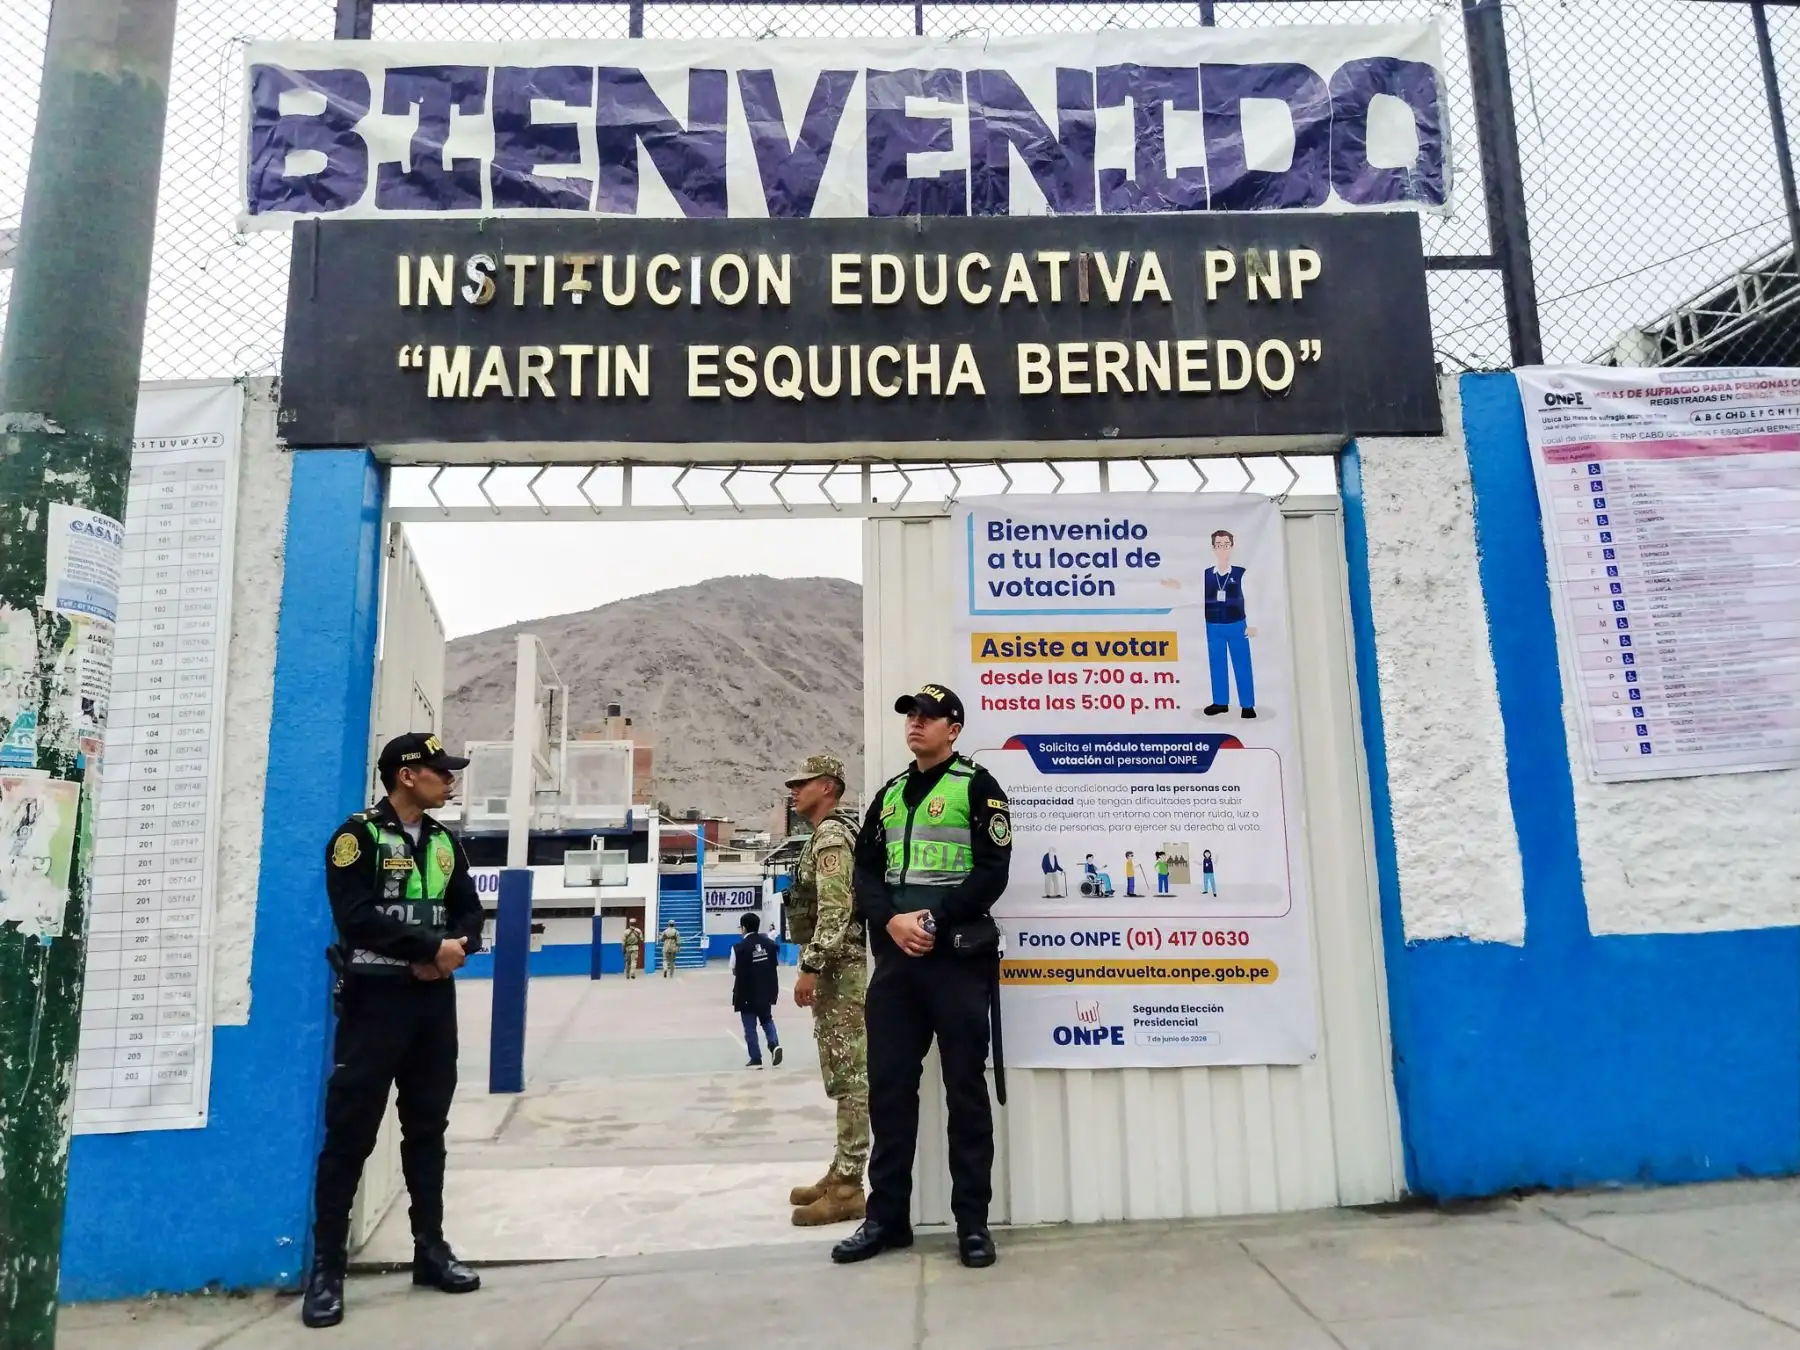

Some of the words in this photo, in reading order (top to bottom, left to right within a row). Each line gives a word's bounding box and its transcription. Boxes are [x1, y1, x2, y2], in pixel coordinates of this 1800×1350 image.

[247, 56, 1448, 218] BIENVENIDO
[398, 252, 791, 307] INSTITUCION
[831, 250, 1171, 305] EDUCATIVA
[1206, 249, 1322, 301] PNP
[688, 342, 986, 402] ESQUICHA
[1544, 392, 1584, 407] ONPE
[1650, 394, 1717, 407] REGISTRADAS
[1720, 393, 1733, 401] EN
[987, 517, 1148, 541] Bienvenido
[987, 551, 1005, 569] a
[1012, 549, 1042, 569] tu
[1049, 547, 1118, 569] local
[1125, 547, 1161, 568] de
[988, 573, 1116, 597] votación
[980, 635, 1065, 658] Asiste
[1071, 641, 1089, 657] a
[1095, 638, 1169, 657] votar
[980, 669, 1043, 685] desde
[1048, 668, 1078, 685] las
[1082, 668, 1125, 684] 7:00
[1154, 672, 1180, 684] m.
[981, 694, 1041, 711] hasta
[1046, 694, 1076, 710] las
[1081, 694, 1125, 710] 5:00
[1154, 696, 1181, 710] m.
[144, 748, 158, 756] 104
[1039, 742, 1080, 753] Solicita
[1081, 742, 1092, 752] el
[1094, 741, 1139, 753] módulo
[1140, 742, 1193, 755] temporal
[1195, 742, 1210, 752] de
[1051, 755, 1102, 766] votación
[1104, 755, 1115, 765] al
[1117, 755, 1166, 767] personal
[1168, 755, 1198, 765] ONPE
[1007, 783, 1053, 793] Ambiente
[1054, 783, 1129, 793] acondicionado
[1130, 785, 1155, 795] para
[1156, 783, 1171, 793] las
[1173, 784, 1220, 795] personas
[1221, 784, 1241, 793] con
[140, 804, 155, 812] 201
[1007, 796, 1075, 808] discapacidad
[1076, 798, 1096, 808] que
[1097, 797, 1133, 808] tengan
[1134, 795, 1191, 806] dificultades
[1193, 798, 1217, 808] para
[1219, 795, 1243, 805] subir
[1048, 809, 1096, 821] requieran
[1098, 811, 1111, 819] un
[1112, 810, 1151, 819] entorno
[1152, 811, 1172, 819] con
[1173, 810, 1206, 819] menor
[1236, 808, 1250, 818] luz
[140, 822, 154, 830] 201
[1044, 822, 1057, 832] de
[1108, 823, 1132, 834] para
[1134, 822, 1168, 834] ejercer
[1170, 824, 1182, 832] su
[1184, 822, 1225, 832] derecho
[1226, 822, 1238, 832] al
[137, 878, 152, 886] 201
[1019, 931, 1066, 947] Fono
[1070, 931, 1121, 947] ONPE
[1126, 927, 1162, 950] (01)
[1168, 931, 1197, 946] 417
[1202, 931, 1250, 946] 0630
[1003, 965, 1270, 982] www.segundavuelta.onpe.gob.pe
[1133, 1004, 1179, 1016] Segunda
[1181, 1003, 1224, 1014] Elección
[1133, 1017, 1198, 1027] Presidencial
[1053, 1025, 1125, 1046] ONPE
[1162, 1035, 1180, 1044] junio
